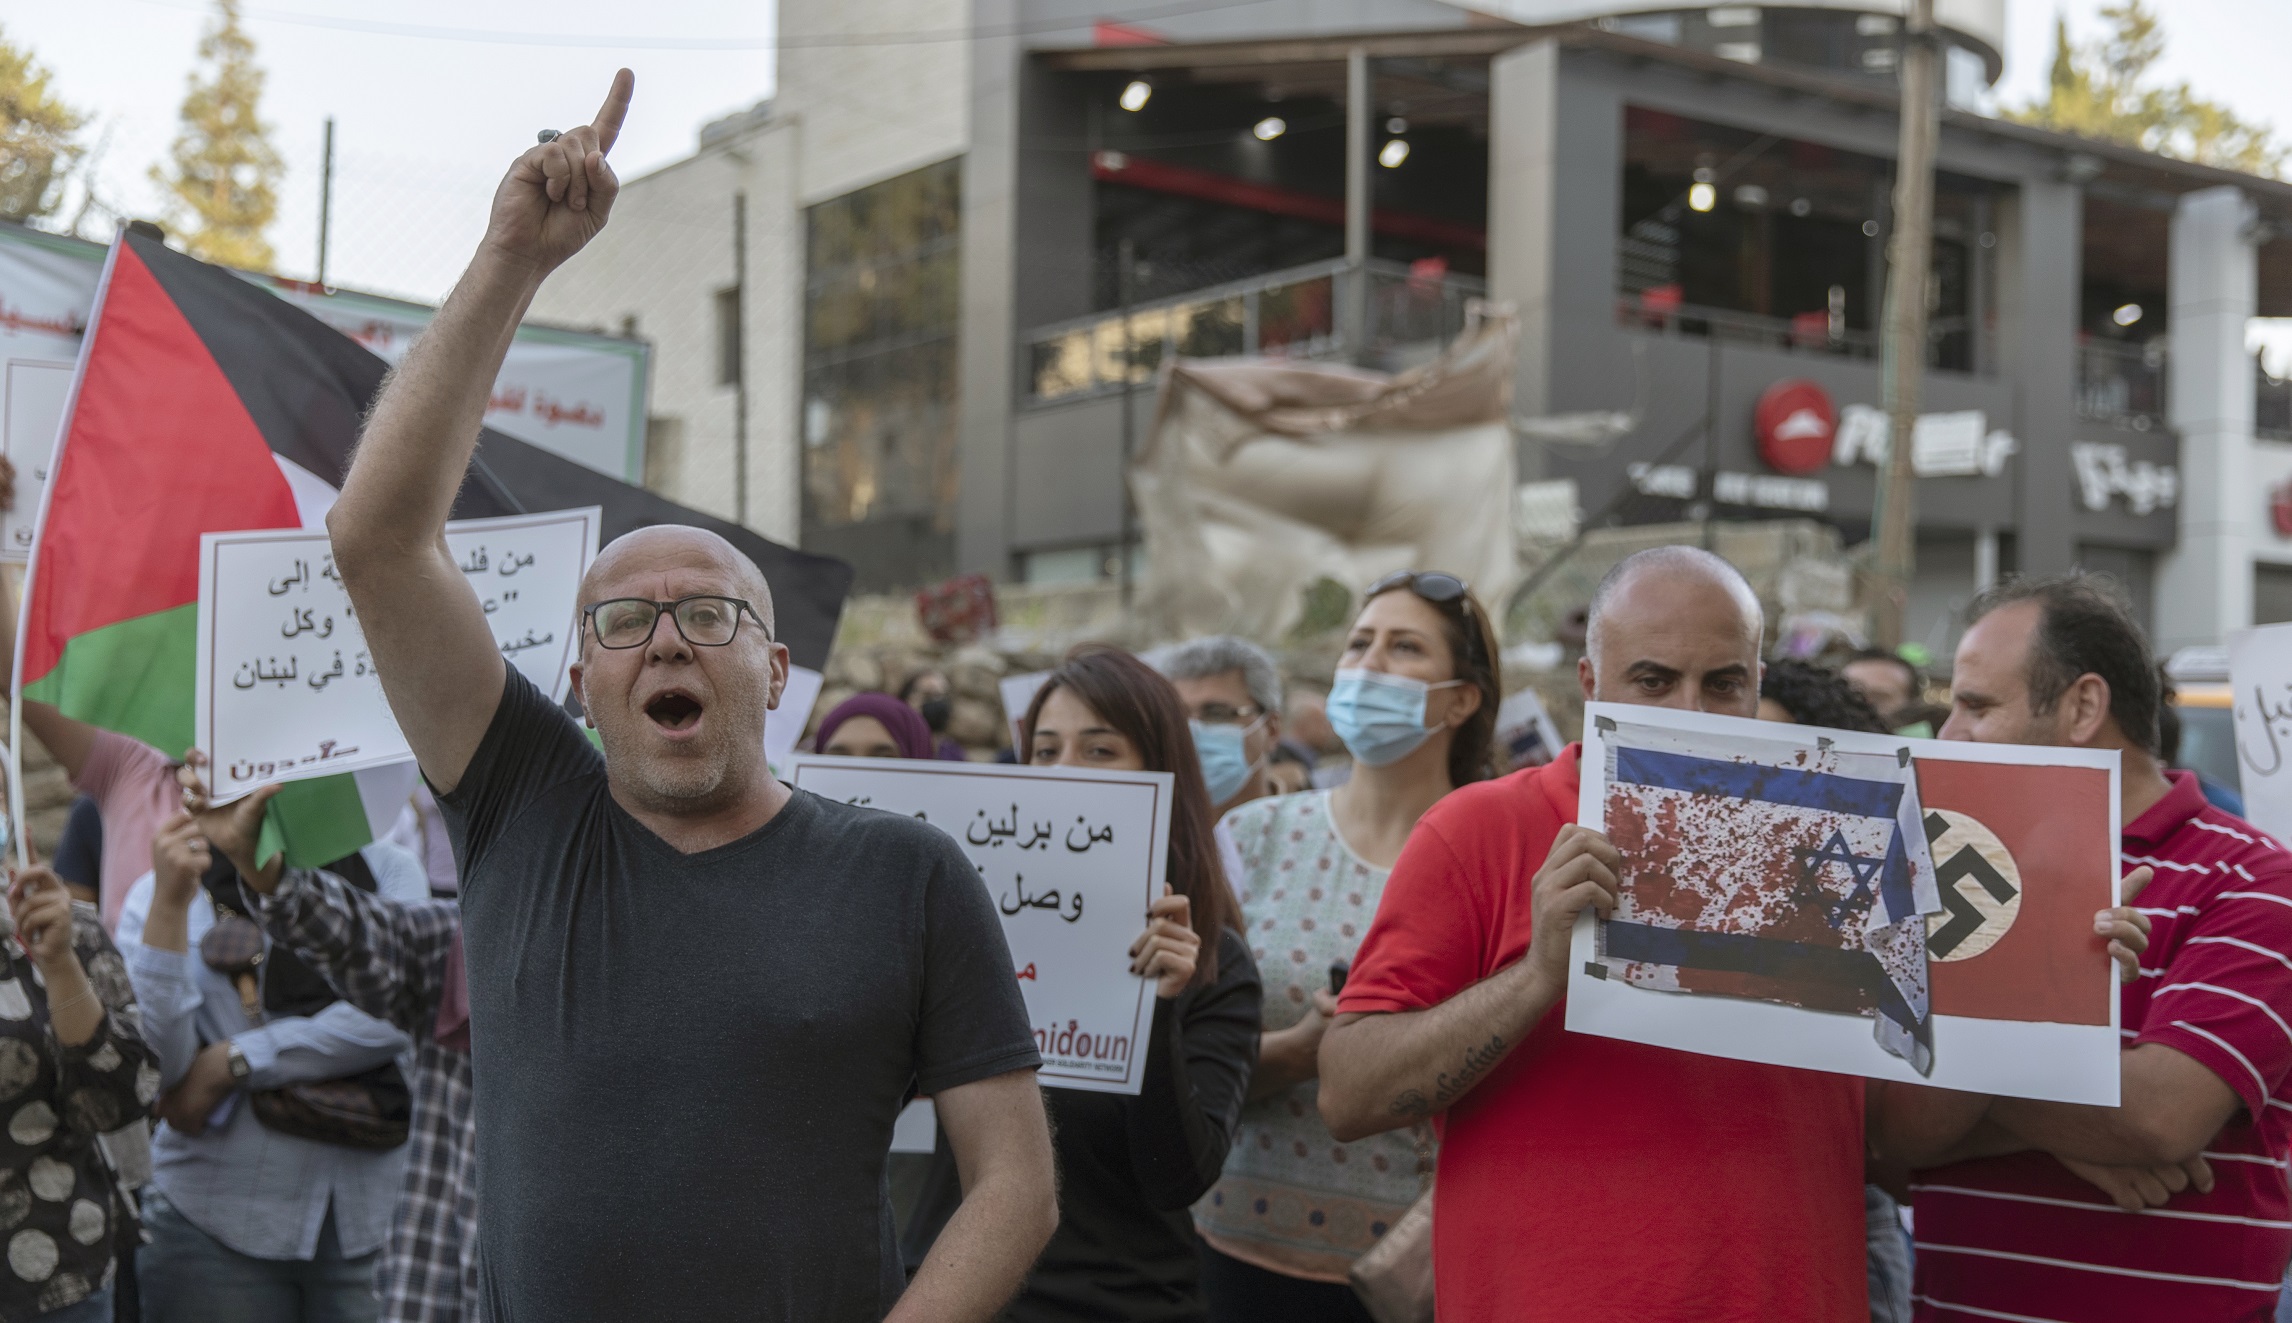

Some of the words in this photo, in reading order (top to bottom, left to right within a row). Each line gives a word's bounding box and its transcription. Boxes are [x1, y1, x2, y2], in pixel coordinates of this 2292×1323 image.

[268, 559, 309, 595] إلى
[499, 552, 534, 577] من
[281, 606, 333, 639] وكل
[234, 655, 297, 689] لبنان
[308, 650, 343, 693] في
[966, 802, 1052, 850] برلين
[1066, 815, 1114, 852] من
[1001, 872, 1084, 923] وصل
